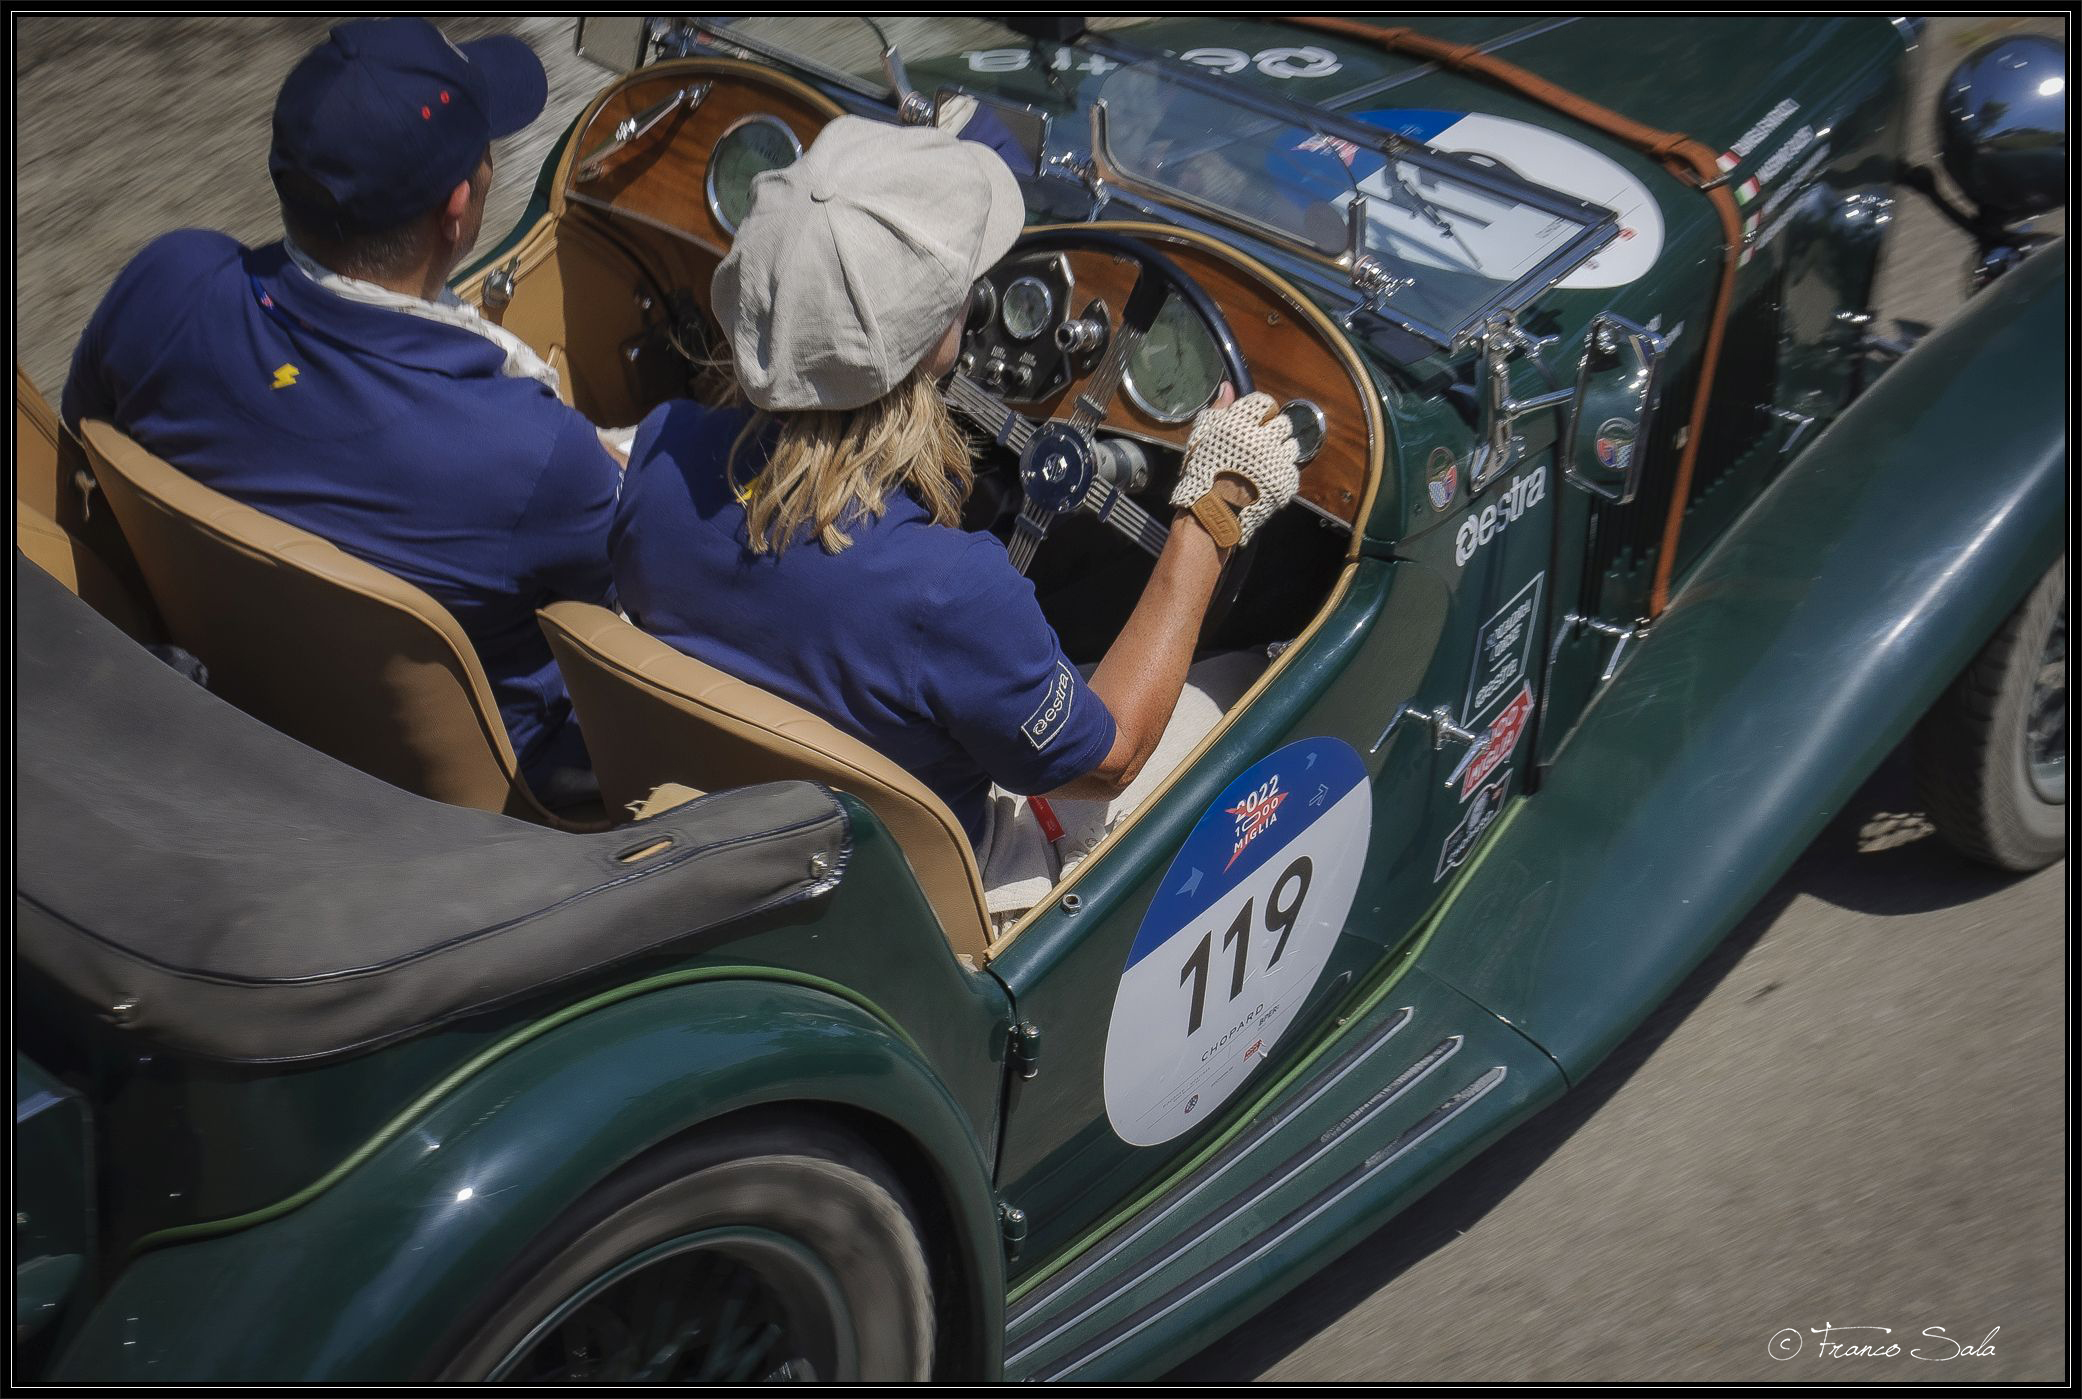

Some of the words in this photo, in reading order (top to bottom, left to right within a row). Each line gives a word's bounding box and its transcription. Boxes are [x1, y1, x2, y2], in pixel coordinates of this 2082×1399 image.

[1478, 465, 1547, 546] estra
[1235, 773, 1280, 823] 2022
[1233, 812, 1278, 854] MIGLIA
[1179, 855, 1313, 1038] 119
[1201, 1003, 1264, 1062] CHOPARD
